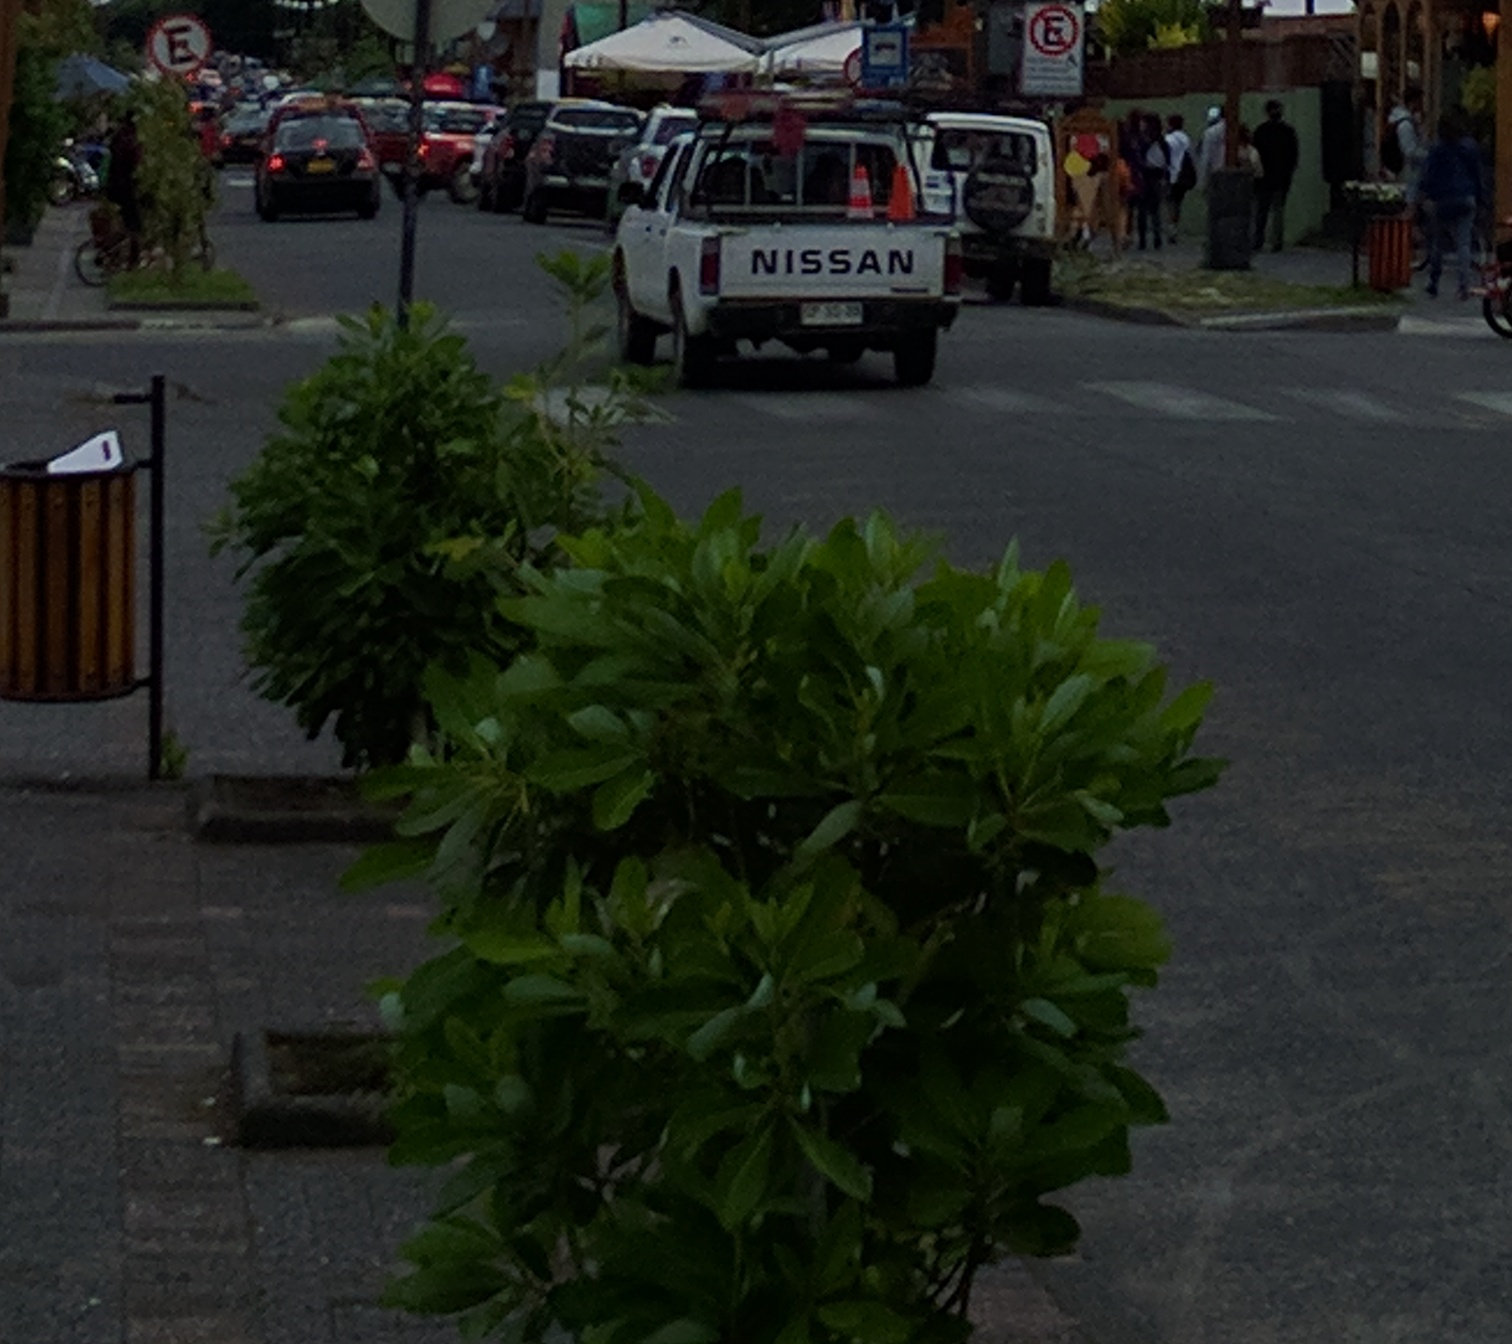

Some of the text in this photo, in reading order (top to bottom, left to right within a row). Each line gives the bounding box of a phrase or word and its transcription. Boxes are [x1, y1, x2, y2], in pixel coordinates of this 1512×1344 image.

[165, 26, 193, 65] E
[1044, 16, 1065, 46] E
[752, 250, 914, 274] NISSAN
